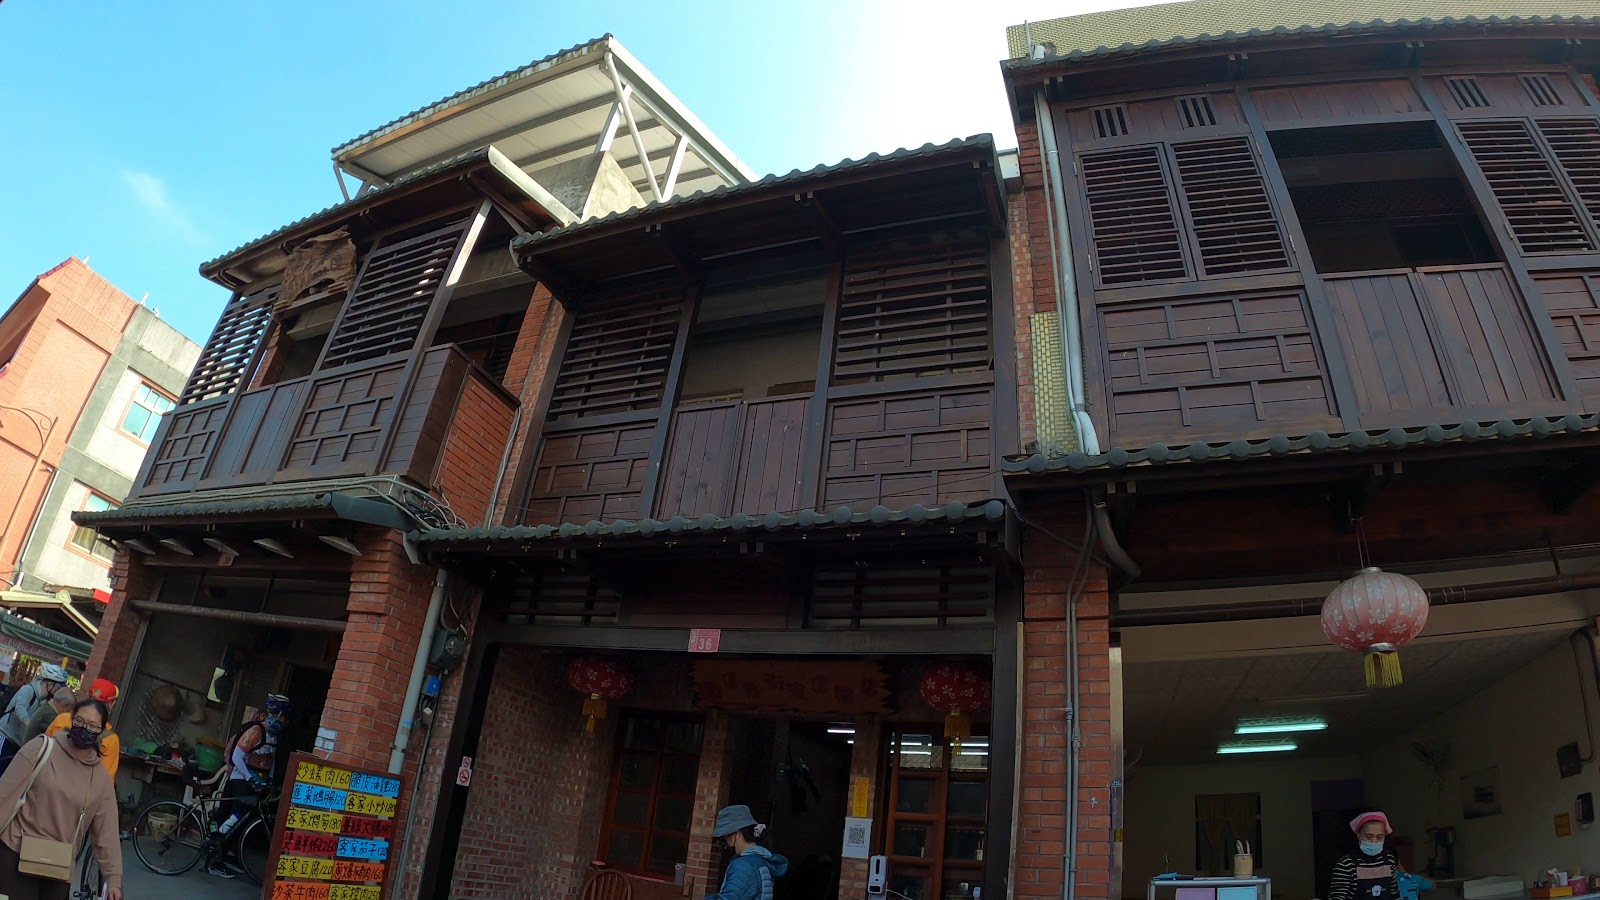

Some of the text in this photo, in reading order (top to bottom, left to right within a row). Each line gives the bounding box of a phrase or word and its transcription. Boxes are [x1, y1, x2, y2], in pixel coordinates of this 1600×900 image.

[698, 638, 712, 650] 36
[347, 792, 395, 813] 客家小炒180
[338, 838, 388, 856] 客家茄子120
[278, 856, 332, 877] 客家豆腐120
